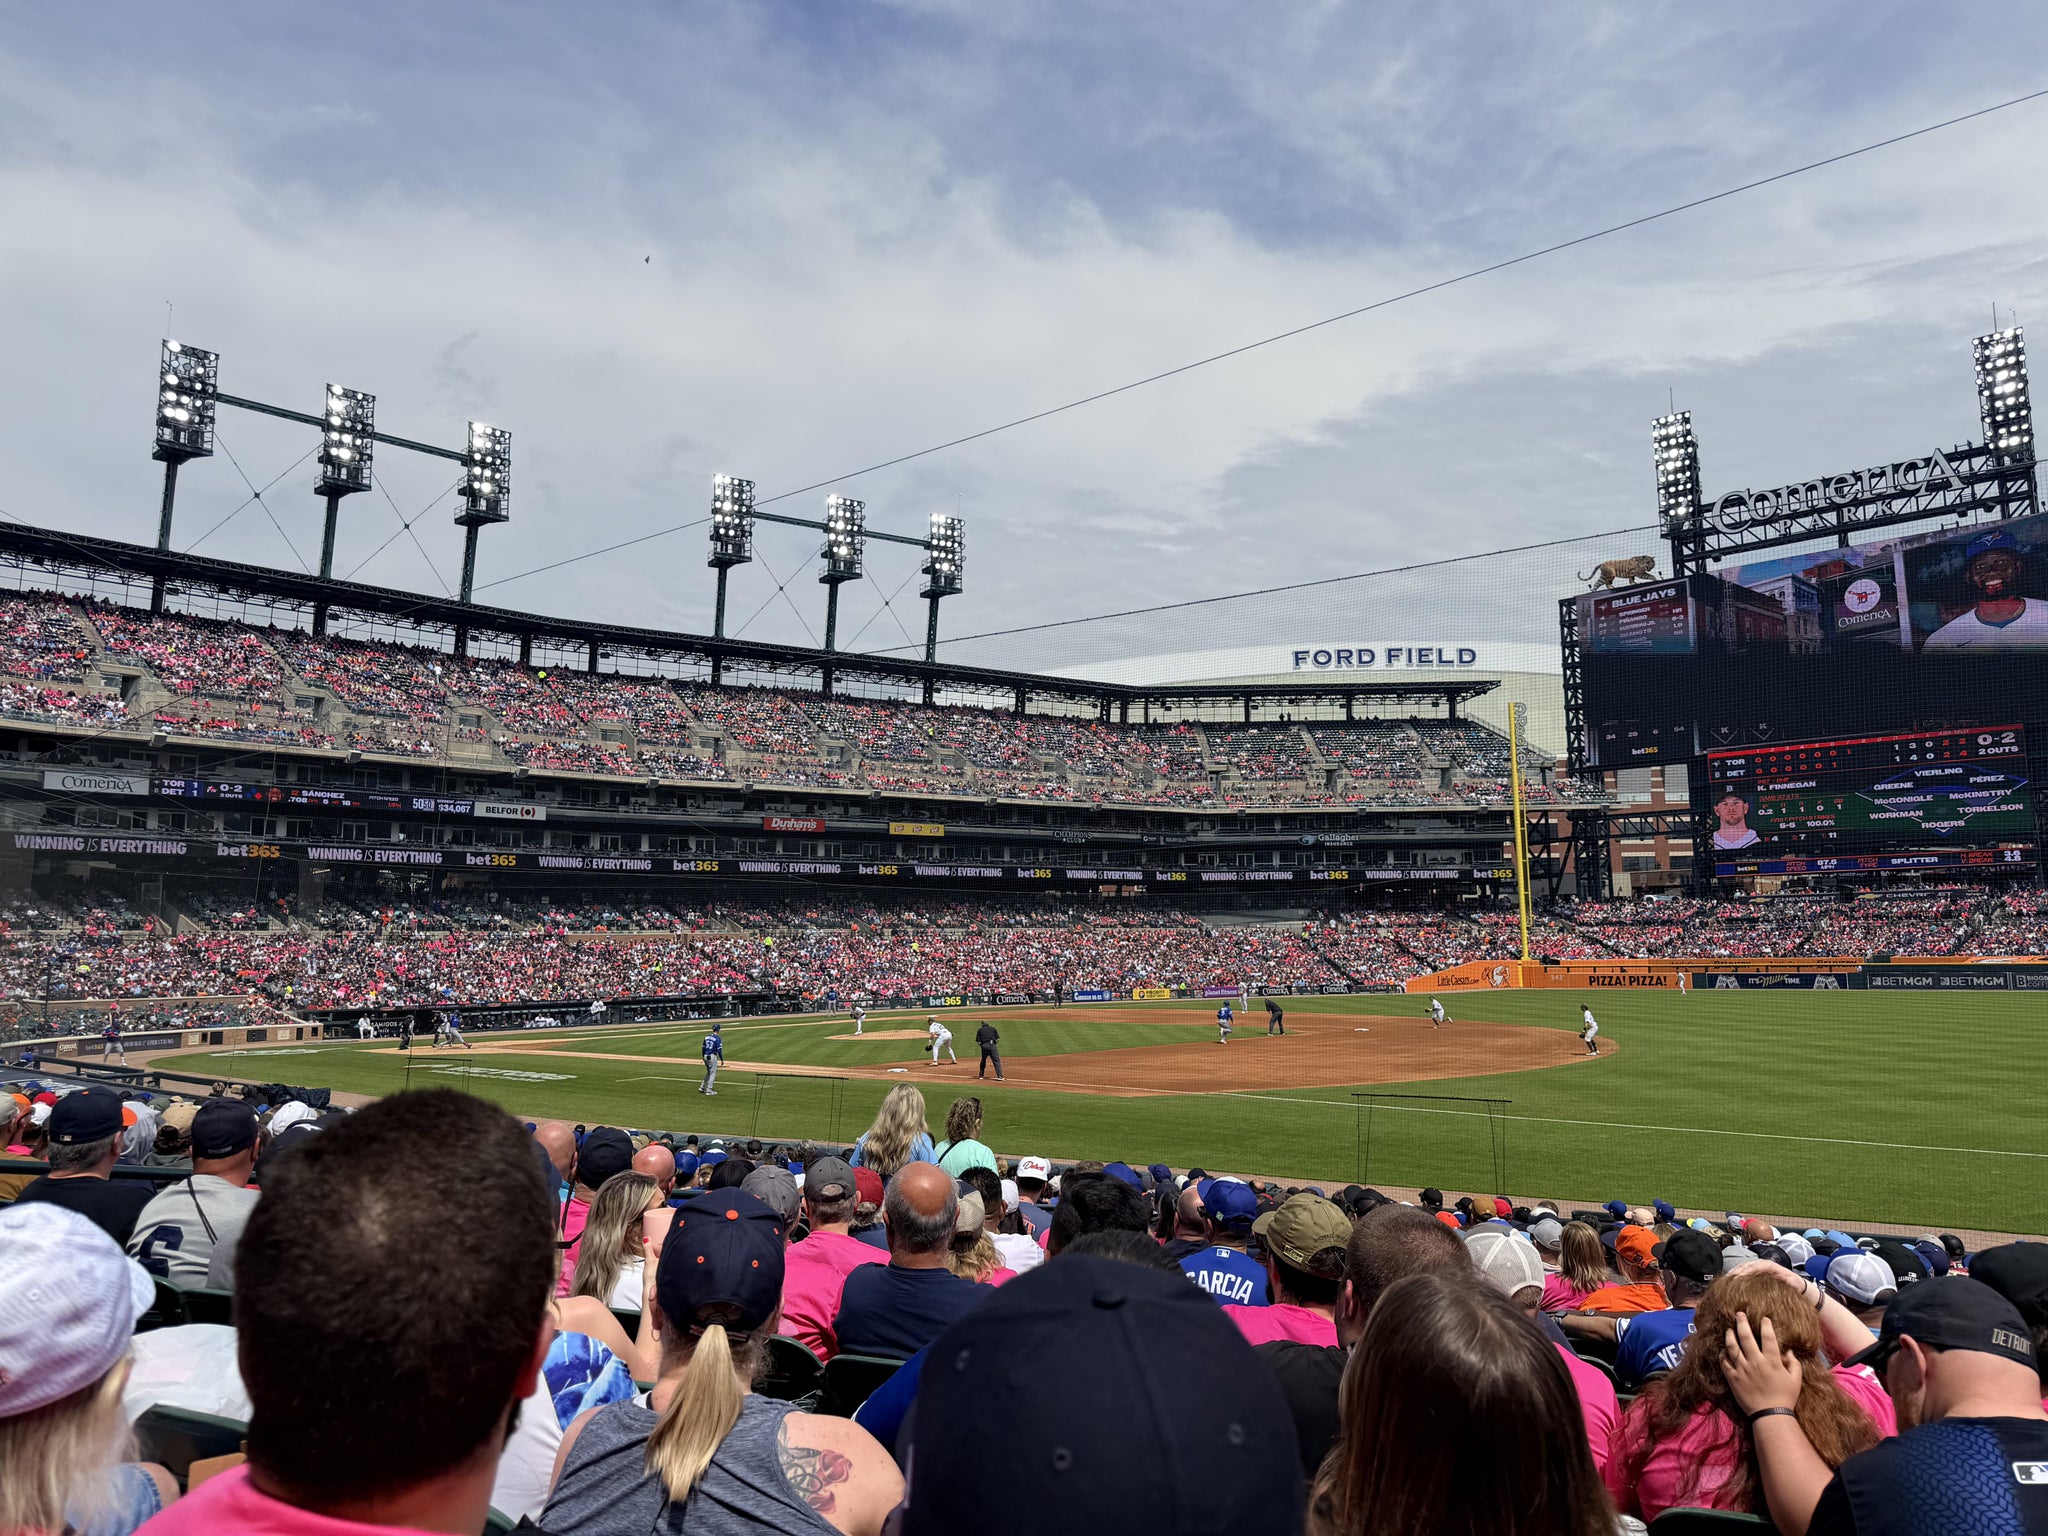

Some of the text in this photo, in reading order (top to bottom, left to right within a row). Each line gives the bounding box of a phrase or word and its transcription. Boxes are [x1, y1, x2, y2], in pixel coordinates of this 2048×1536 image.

[1778, 500, 1895, 536] PARK
[1611, 588, 1676, 608] BLUE JAYS
[1293, 647, 1477, 668] FORD FIELD
[1977, 732, 2015, 745] 0-2
[1632, 746, 1658, 755] bet365
[1987, 745, 2019, 754] OUTS
[1914, 767, 1963, 777] VIERLING
[162, 779, 185, 787] TOR
[1969, 774, 2005, 784] PÉREZ
[220, 784, 243, 792] 0-2
[1769, 781, 1816, 790] FINNEGAN
[1873, 782, 1914, 791] GREENE
[162, 788, 184, 796] DET
[302, 789, 344, 799] SÁNCHEZ
[1949, 788, 2013, 800] McKINSTRY
[1874, 795, 1933, 805] McGONIGLE
[485, 806, 518, 815] BELFOR
[1957, 803, 2023, 814] TORKELSON
[1869, 810, 1923, 820] WORKMAN
[771, 817, 818, 829] Dunham's
[1806, 819, 1835, 827] 100.0%
[1921, 820, 1965, 829] ROGERS
[1054, 831, 1093, 839] CHAMPIONS
[1318, 833, 1359, 842] Gallagher
[14, 835, 187, 854] WINNING IS EVERYTHING
[217, 842, 280, 858] bet365
[307, 847, 442, 864] WINNING IS EVERYTHING
[466, 853, 517, 866] bet365
[538, 856, 652, 870] WINNING IS EVERYTHING
[673, 860, 719, 872] bet365
[1891, 857, 1939, 865] SPLITTER
[739, 862, 841, 874] WINNING IS EVERYTHING
[858, 864, 898, 875] bet365
[914, 866, 1002, 877] WINNING IS EVERYTHING
[1017, 868, 1052, 878] bet365
[1066, 869, 1143, 880] WINNING IS EVERYTHING
[1156, 871, 1187, 881] bet365
[1201, 871, 1293, 881] WINNING IS EVERYTHING
[1310, 870, 1348, 880] bet365
[1365, 869, 1459, 879] WINNING IS EVERYTHING
[1473, 869, 1512, 879] bet365
[1589, 975, 1667, 986] PIZZA! PIZZA!
[1882, 977, 1933, 986] BETMGM
[1951, 976, 2004, 986] BETMGM
[929, 996, 961, 1006] bet365
[705, 1040, 713, 1049] 53
[1992, 1328, 2031, 1356] DETROIT
